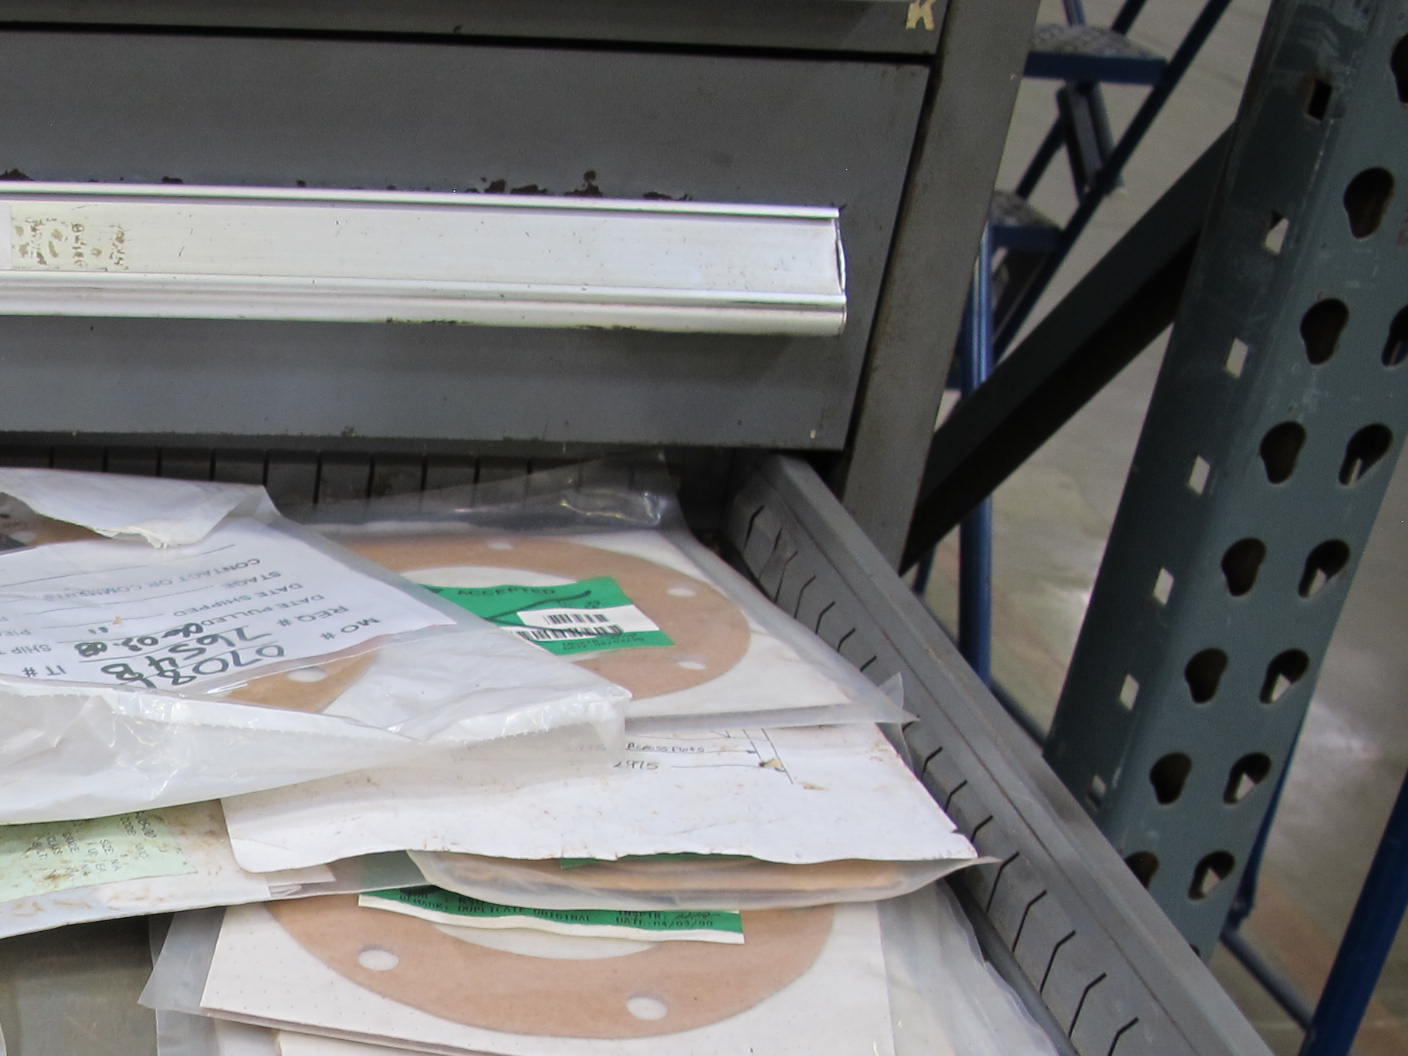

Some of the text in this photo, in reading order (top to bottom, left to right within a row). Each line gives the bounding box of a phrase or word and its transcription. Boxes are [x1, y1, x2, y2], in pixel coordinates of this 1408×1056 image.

[173, 583, 304, 617] DATE SHIPPED
[201, 593, 326, 627] DATE PULLED
[276, 605, 350, 628] REQ #
[319, 616, 381, 642] MO #
[10, 644, 53, 657] SHIP
[22, 664, 68, 679] IT #
